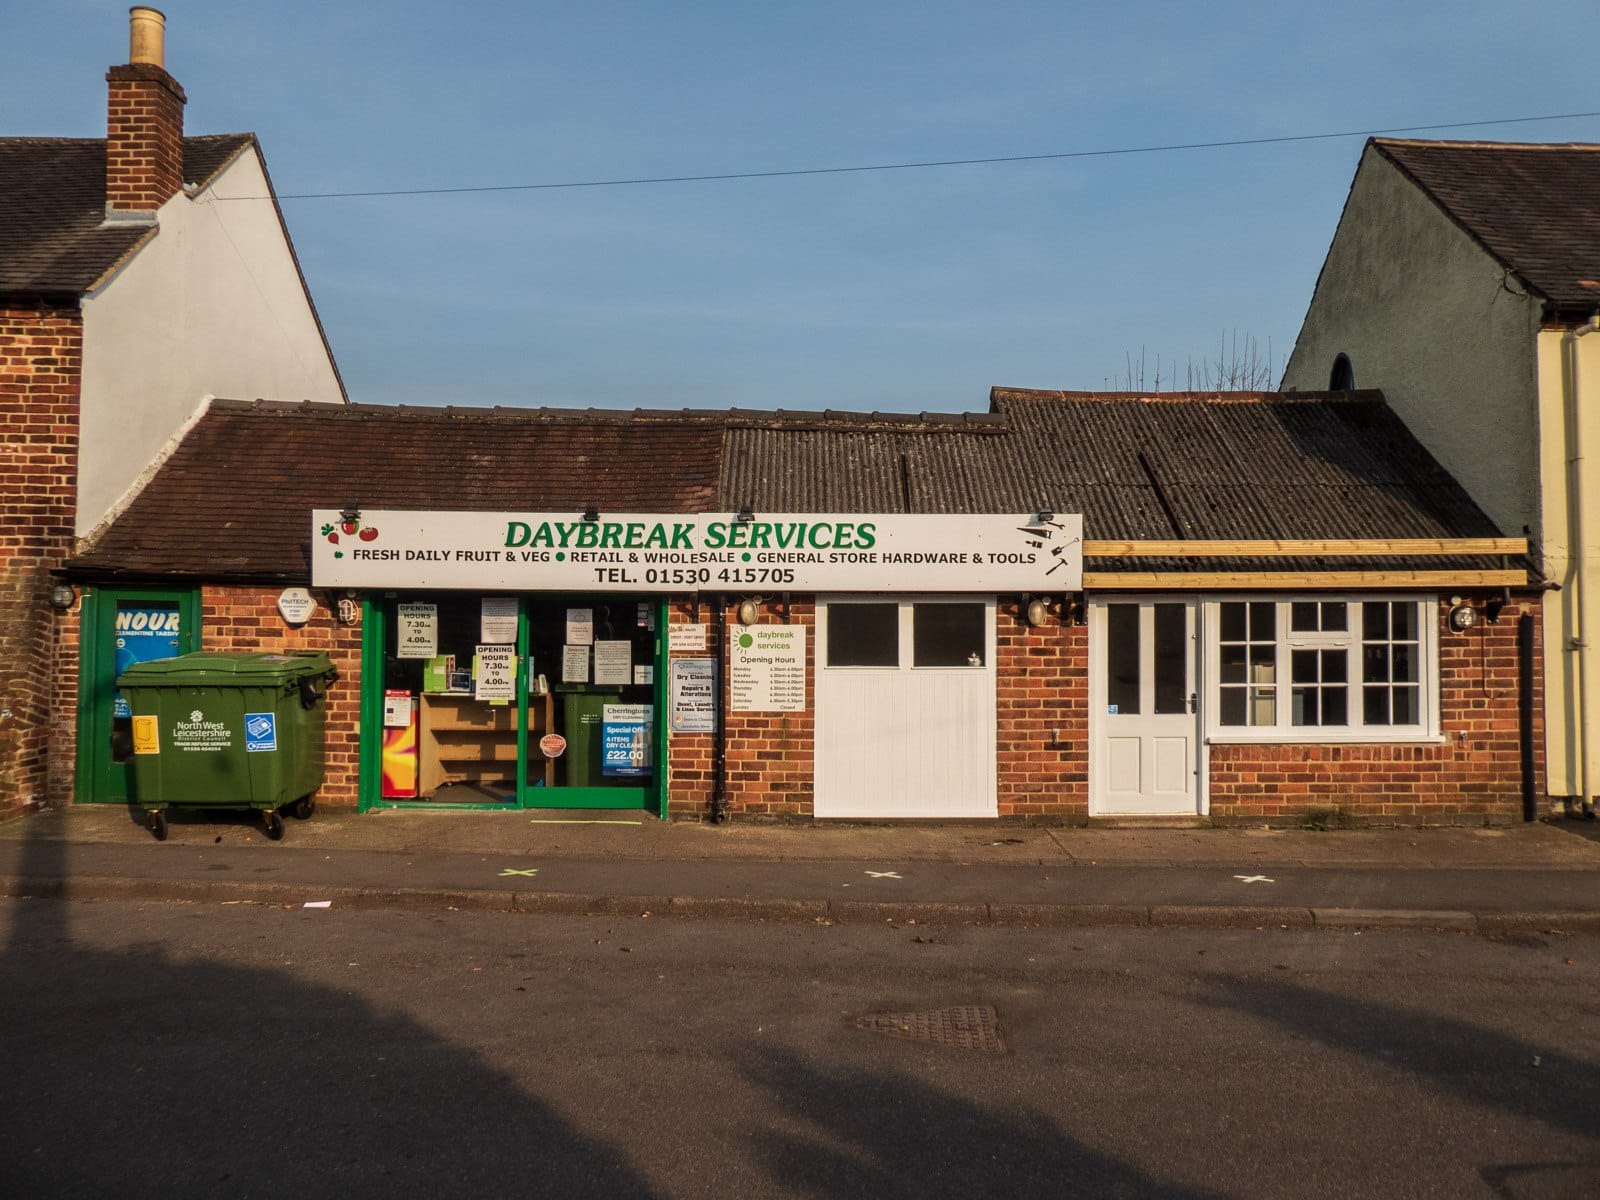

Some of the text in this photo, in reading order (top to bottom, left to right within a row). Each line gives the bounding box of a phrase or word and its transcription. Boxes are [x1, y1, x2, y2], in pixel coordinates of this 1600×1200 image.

[503, 521, 877, 550] DAYBREAK SERVICES
[353, 549, 1037, 564] FRESH DAILY FRUIT & VEG RETAIL & WHOLESALE GENERAL STORE HARDWARE & TOOLS
[594, 567, 796, 585] TEL. 01530 415705
[115, 612, 180, 631] NOUR
[757, 631, 794, 640] daybreak
[757, 642, 791, 650] services
[740, 656, 773, 664] Opening
[607, 707, 650, 716] Cherringtons
[177, 721, 225, 730] North West
[173, 728, 231, 737] Leicestershire
[607, 726, 632, 735] Special
[606, 750, 644, 761] £22.00
